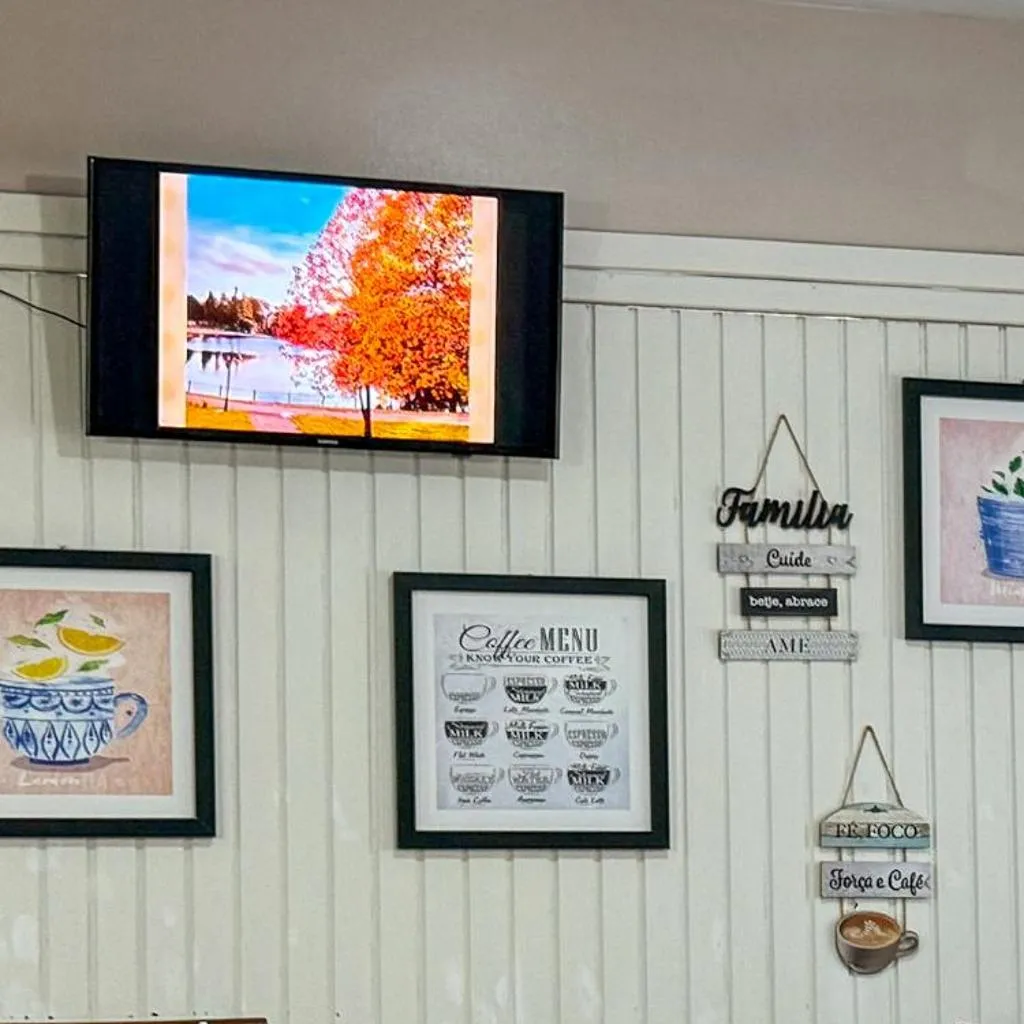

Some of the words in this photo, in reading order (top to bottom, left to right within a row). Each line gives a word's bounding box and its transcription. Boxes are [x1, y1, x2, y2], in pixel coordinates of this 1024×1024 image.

[766, 548, 812, 568] Cuide
[785, 596, 828, 607] abrace
[459, 624, 535, 660] Coffee
[540, 627, 598, 652] MENU
[766, 638, 811, 653] AME
[466, 653, 502, 664] KNOW
[507, 654, 540, 664] YOUR
[544, 655, 593, 665] COFFEE
[450, 728, 483, 738] MILK
[510, 731, 543, 740] MILK
[867, 824, 918, 839] FOCO
[829, 868, 873, 893] Força
[876, 876, 884, 885] e
[888, 869, 924, 896] Café
